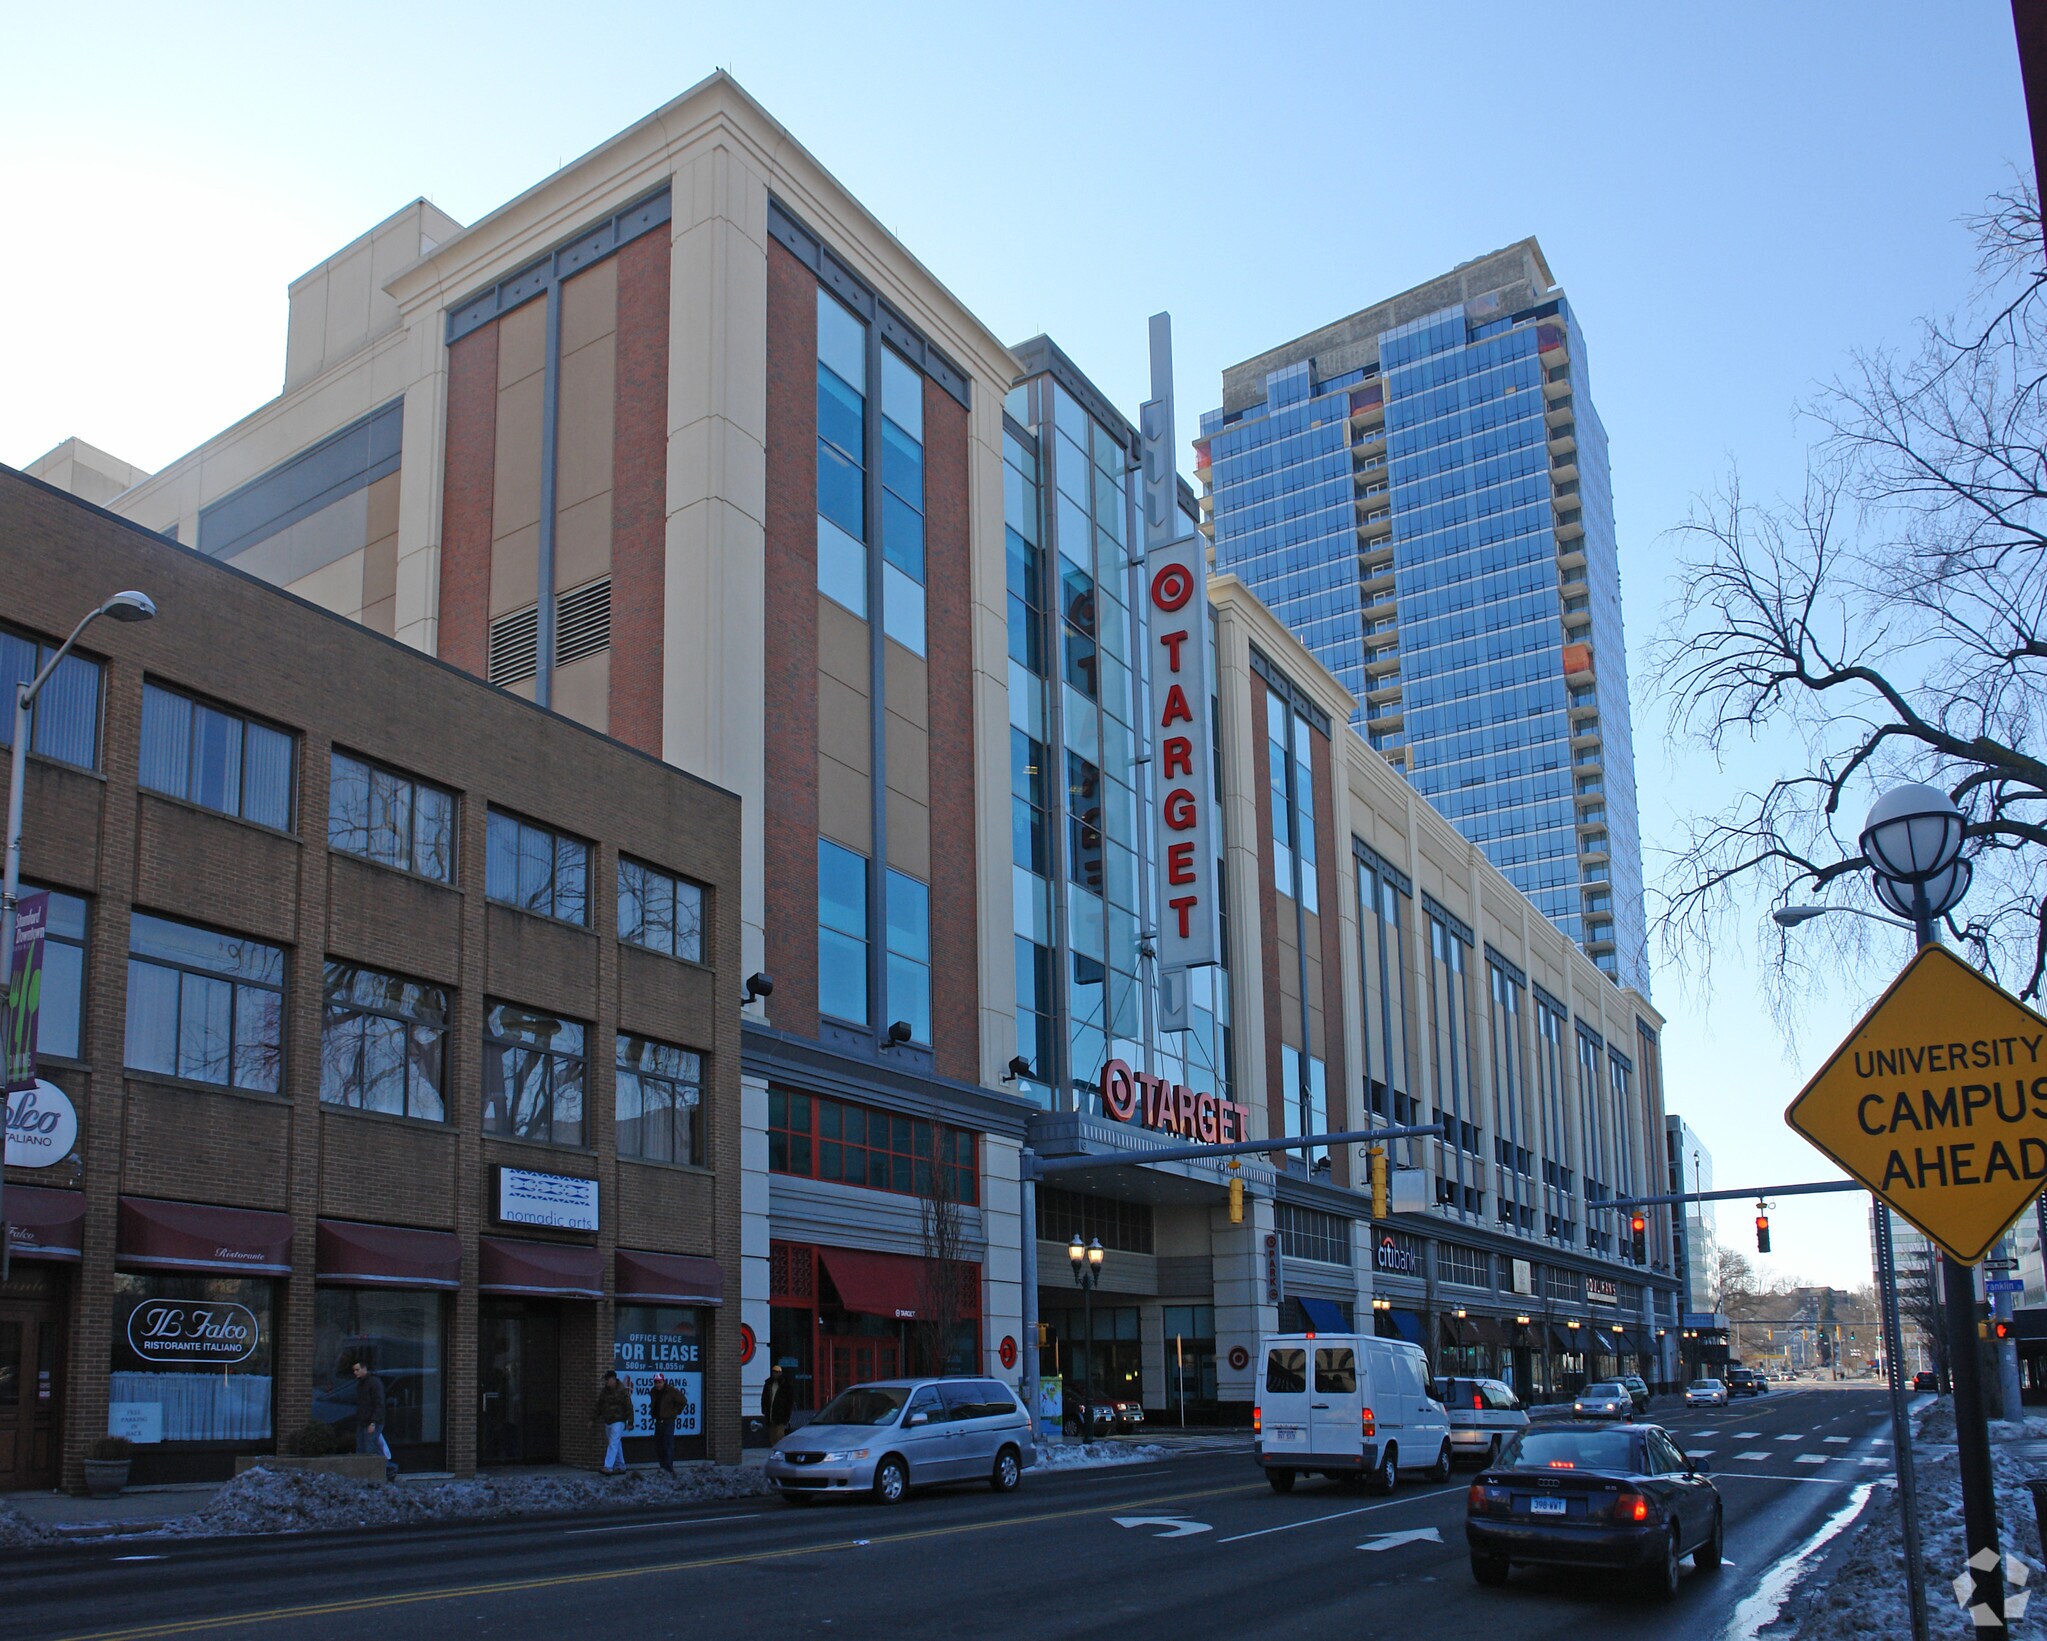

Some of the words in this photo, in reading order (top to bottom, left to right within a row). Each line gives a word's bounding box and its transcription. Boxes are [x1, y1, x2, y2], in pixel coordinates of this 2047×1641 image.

[1160, 630, 1197, 938] TARGET
[15, 906, 42, 929] Stamford
[15, 927, 45, 944] Downtown
[1855, 1034, 2043, 1079] UNIVERSITY
[5, 1092, 61, 1133] lco
[1134, 1071, 1249, 1145] TARGET
[1858, 1077, 2047, 1136] CAMPUS
[1881, 1137, 2047, 1191] AHEAD
[507, 1210, 564, 1227] nomadic
[568, 1217, 592, 1230] arts
[214, 1247, 265, 1261] Ristorante
[1269, 1250, 1277, 1287] PARK
[1378, 1243, 1416, 1272] citibank
[1986, 1282, 2014, 1290] ranklin
[185, 1310, 248, 1339] Falco
[630, 1333, 657, 1342] OFFICE
[659, 1334, 682, 1343] SPACE
[144, 1341, 201, 1351] RISTORANTE
[203, 1342, 243, 1352] ITALIANO
[613, 1343, 645, 1360] FOR
[651, 1344, 698, 1361] LEASE
